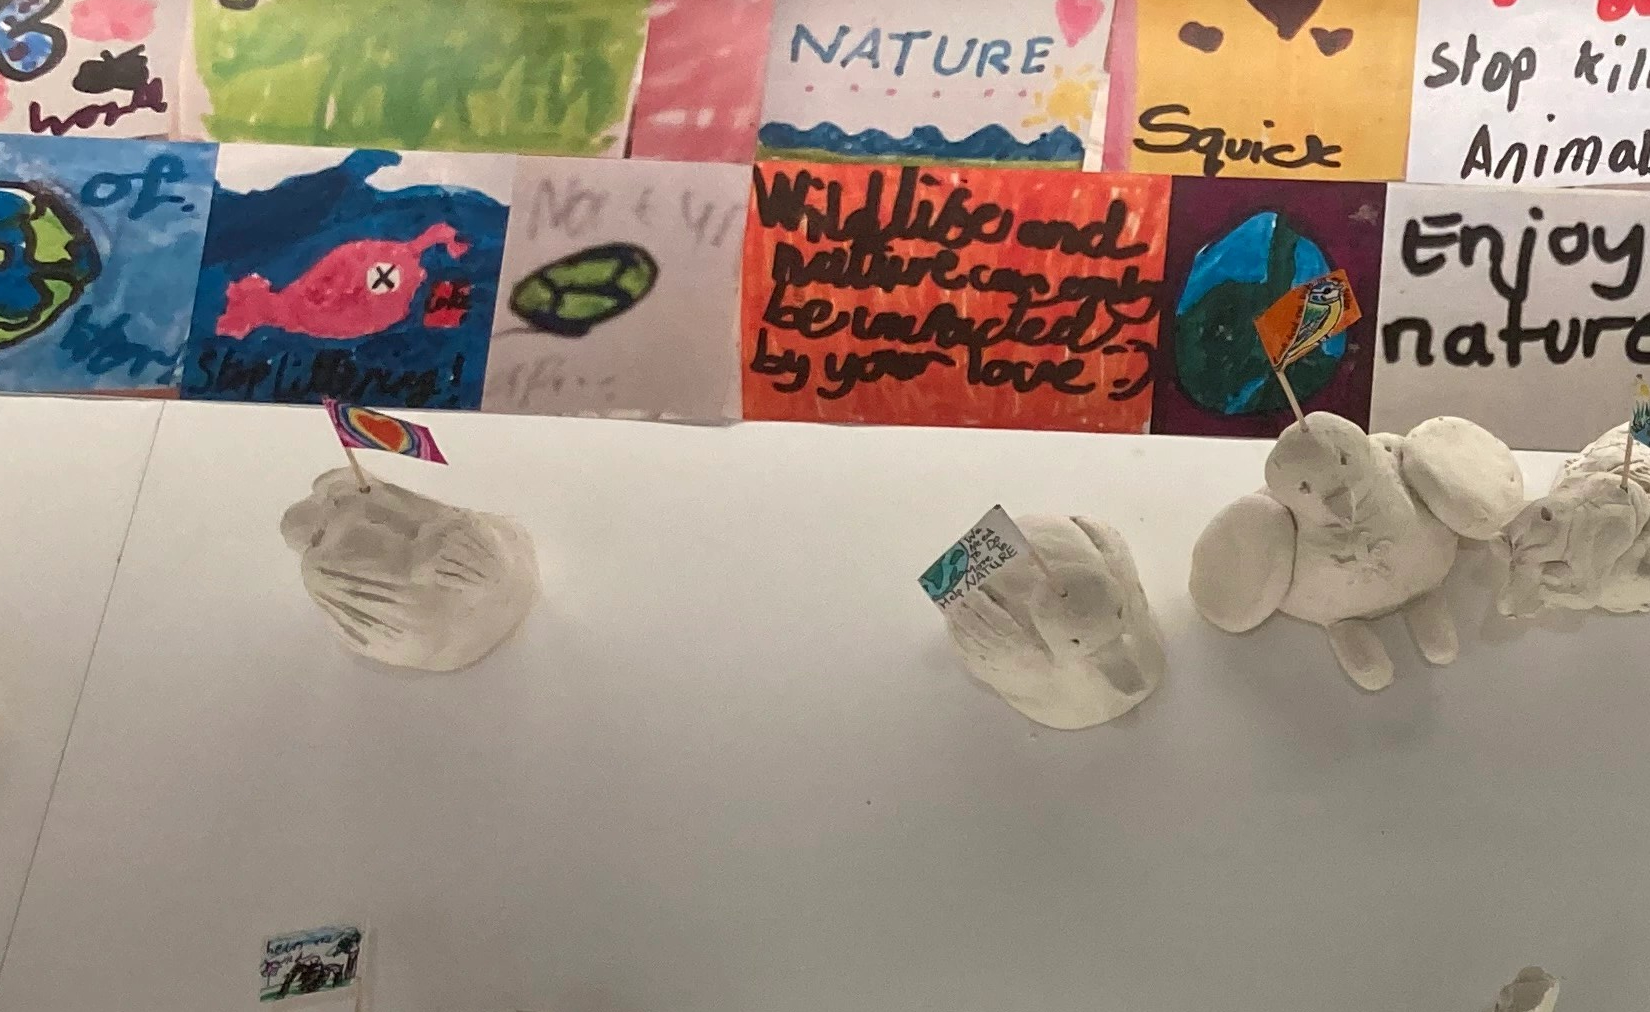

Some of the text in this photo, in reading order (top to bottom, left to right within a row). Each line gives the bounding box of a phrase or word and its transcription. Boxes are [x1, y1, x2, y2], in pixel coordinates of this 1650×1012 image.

[790, 23, 1055, 78] NATURE
[1132, 103, 1343, 177] Squick
[1017, 200, 1148, 259] and
[1401, 206, 1645, 304] Enjoy
[762, 282, 851, 340] be
[750, 328, 1096, 401] by your love
